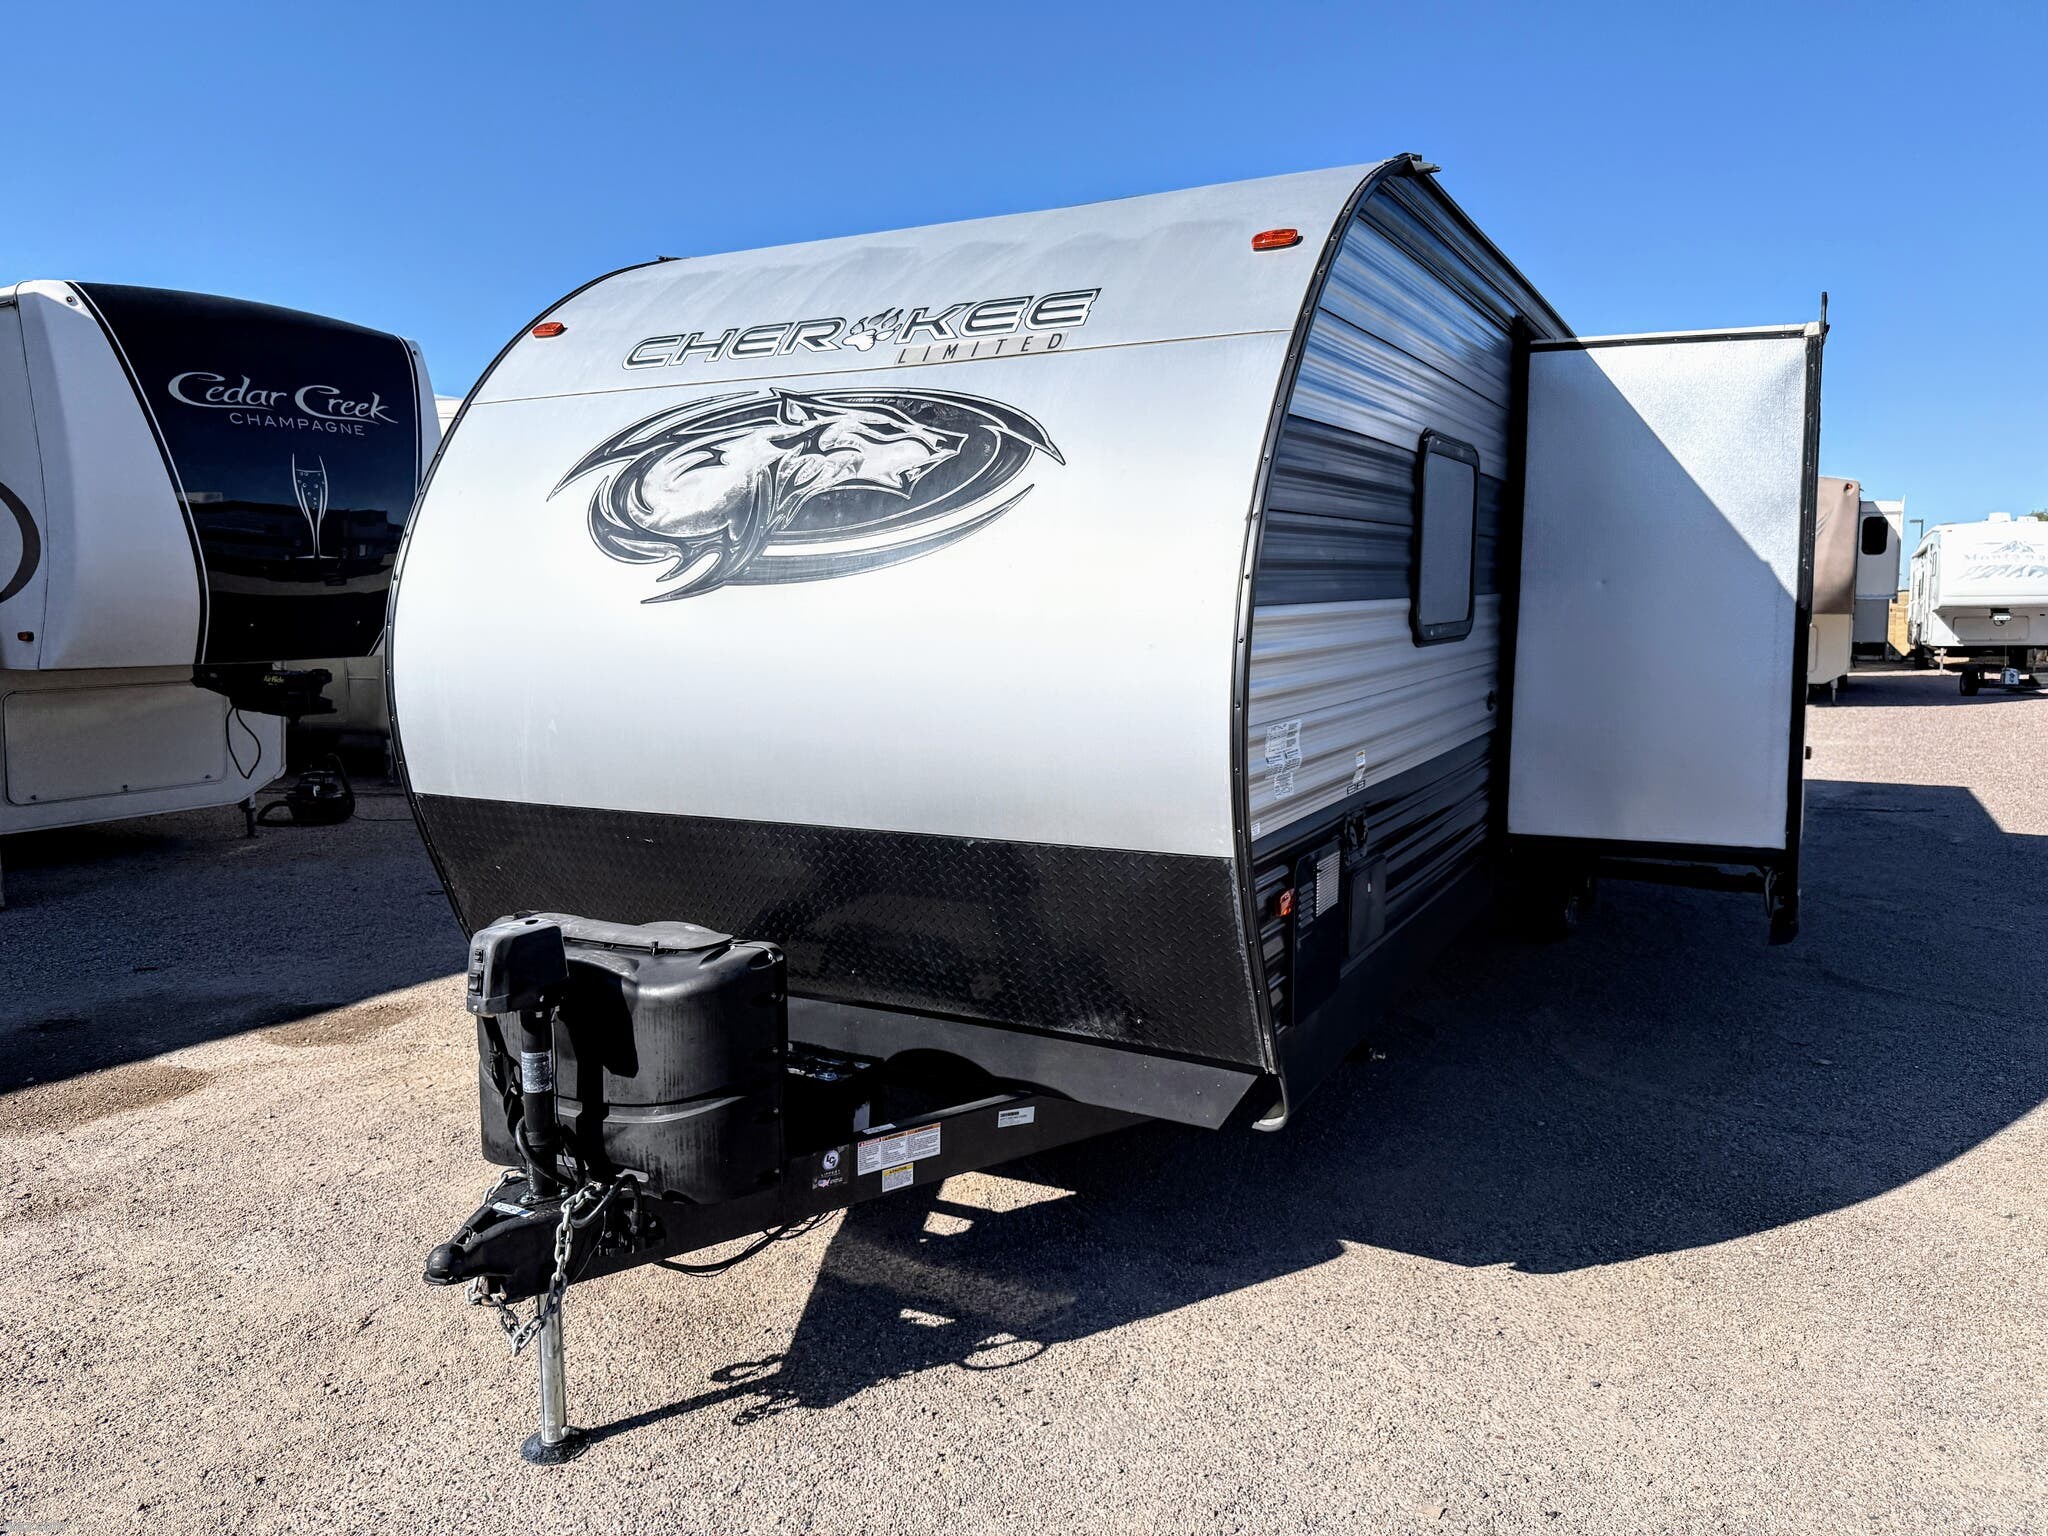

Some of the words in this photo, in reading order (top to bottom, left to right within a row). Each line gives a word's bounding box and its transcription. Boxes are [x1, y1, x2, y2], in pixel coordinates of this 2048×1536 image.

[898, 333, 1065, 365] LIMITED
[168, 371, 287, 411] Cedar
[294, 384, 399, 425] Creek
[229, 412, 366, 436] CHAMPAGNE
